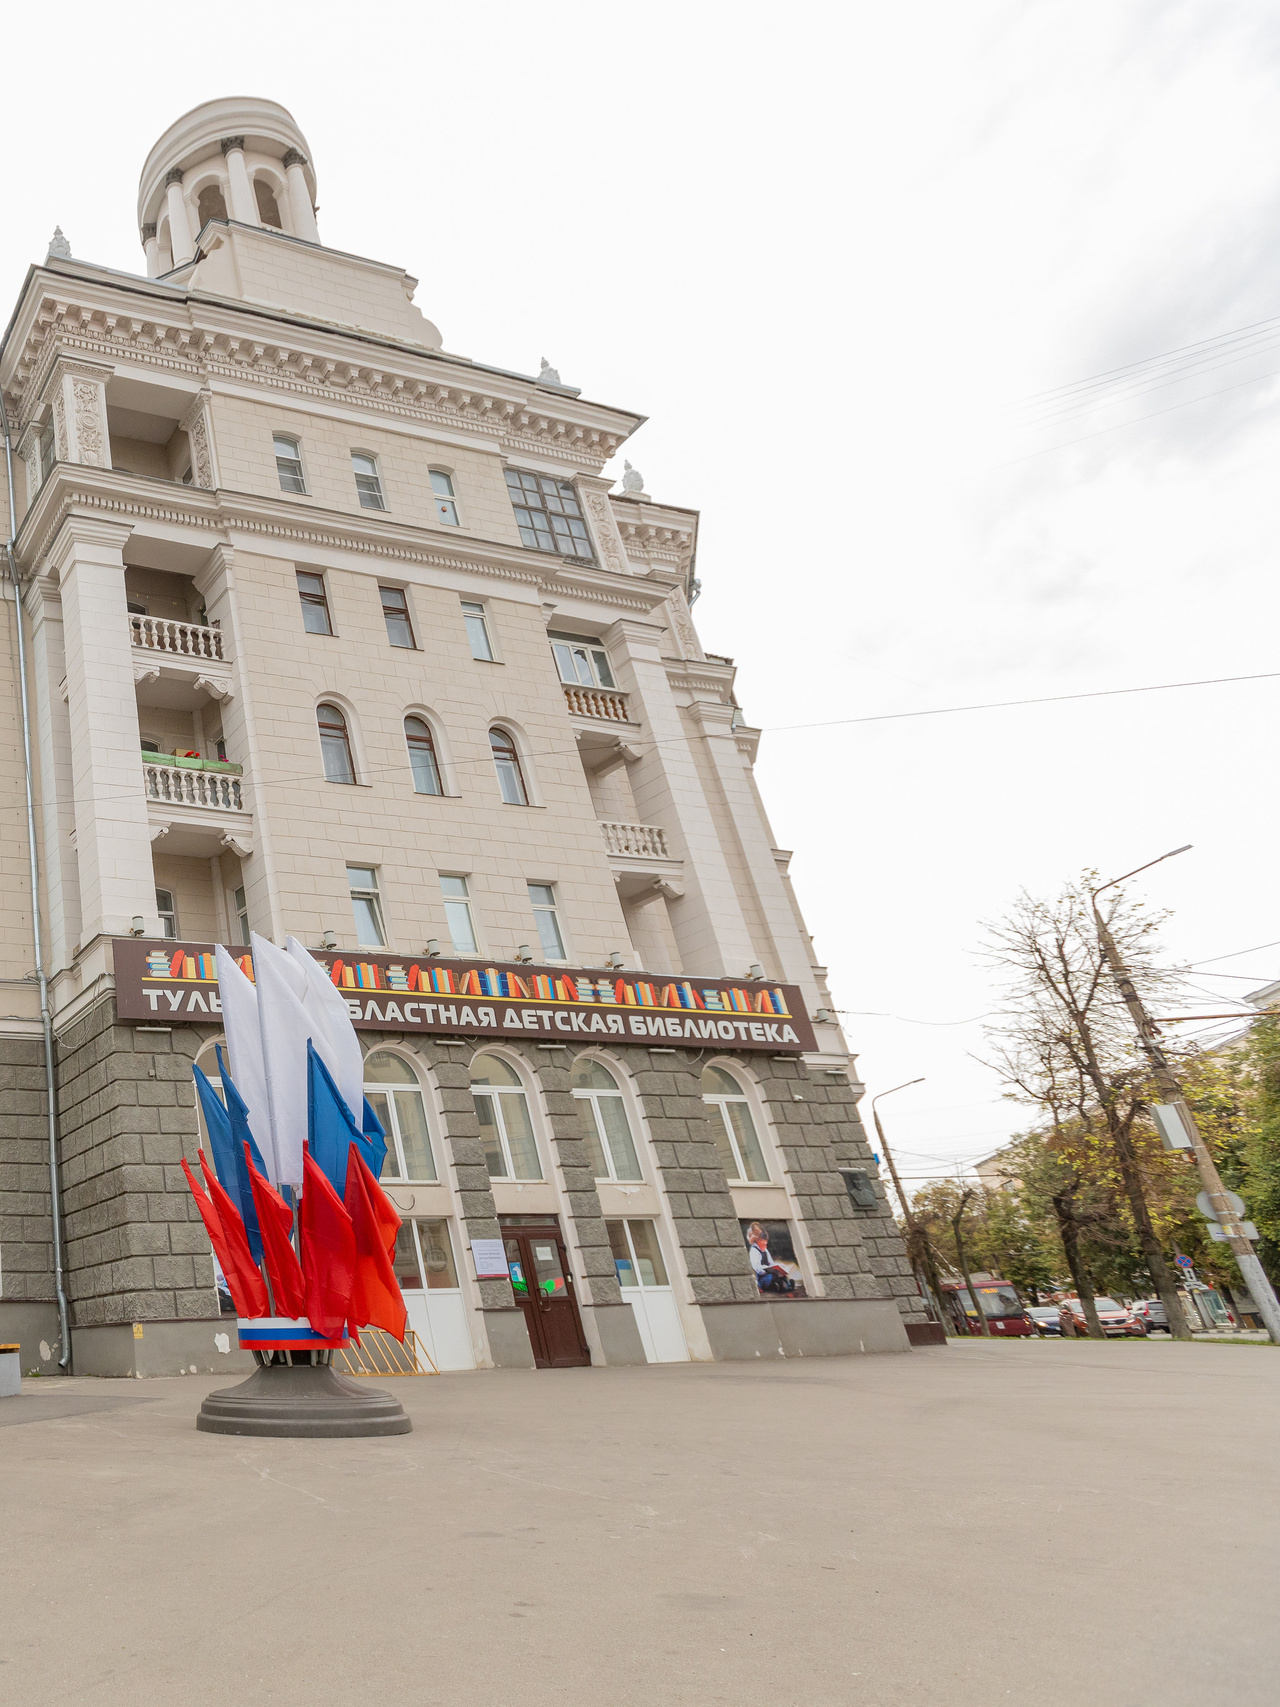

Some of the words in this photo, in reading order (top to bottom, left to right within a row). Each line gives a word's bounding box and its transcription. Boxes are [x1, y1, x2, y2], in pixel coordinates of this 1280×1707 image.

[142, 988, 223, 1013] ТУЛЬ
[348, 998, 497, 1028] БЛАСТНАЯ
[503, 1008, 625, 1034] ДЕТСКАЯ
[628, 1015, 801, 1044] БИБЛИОТЕКА
